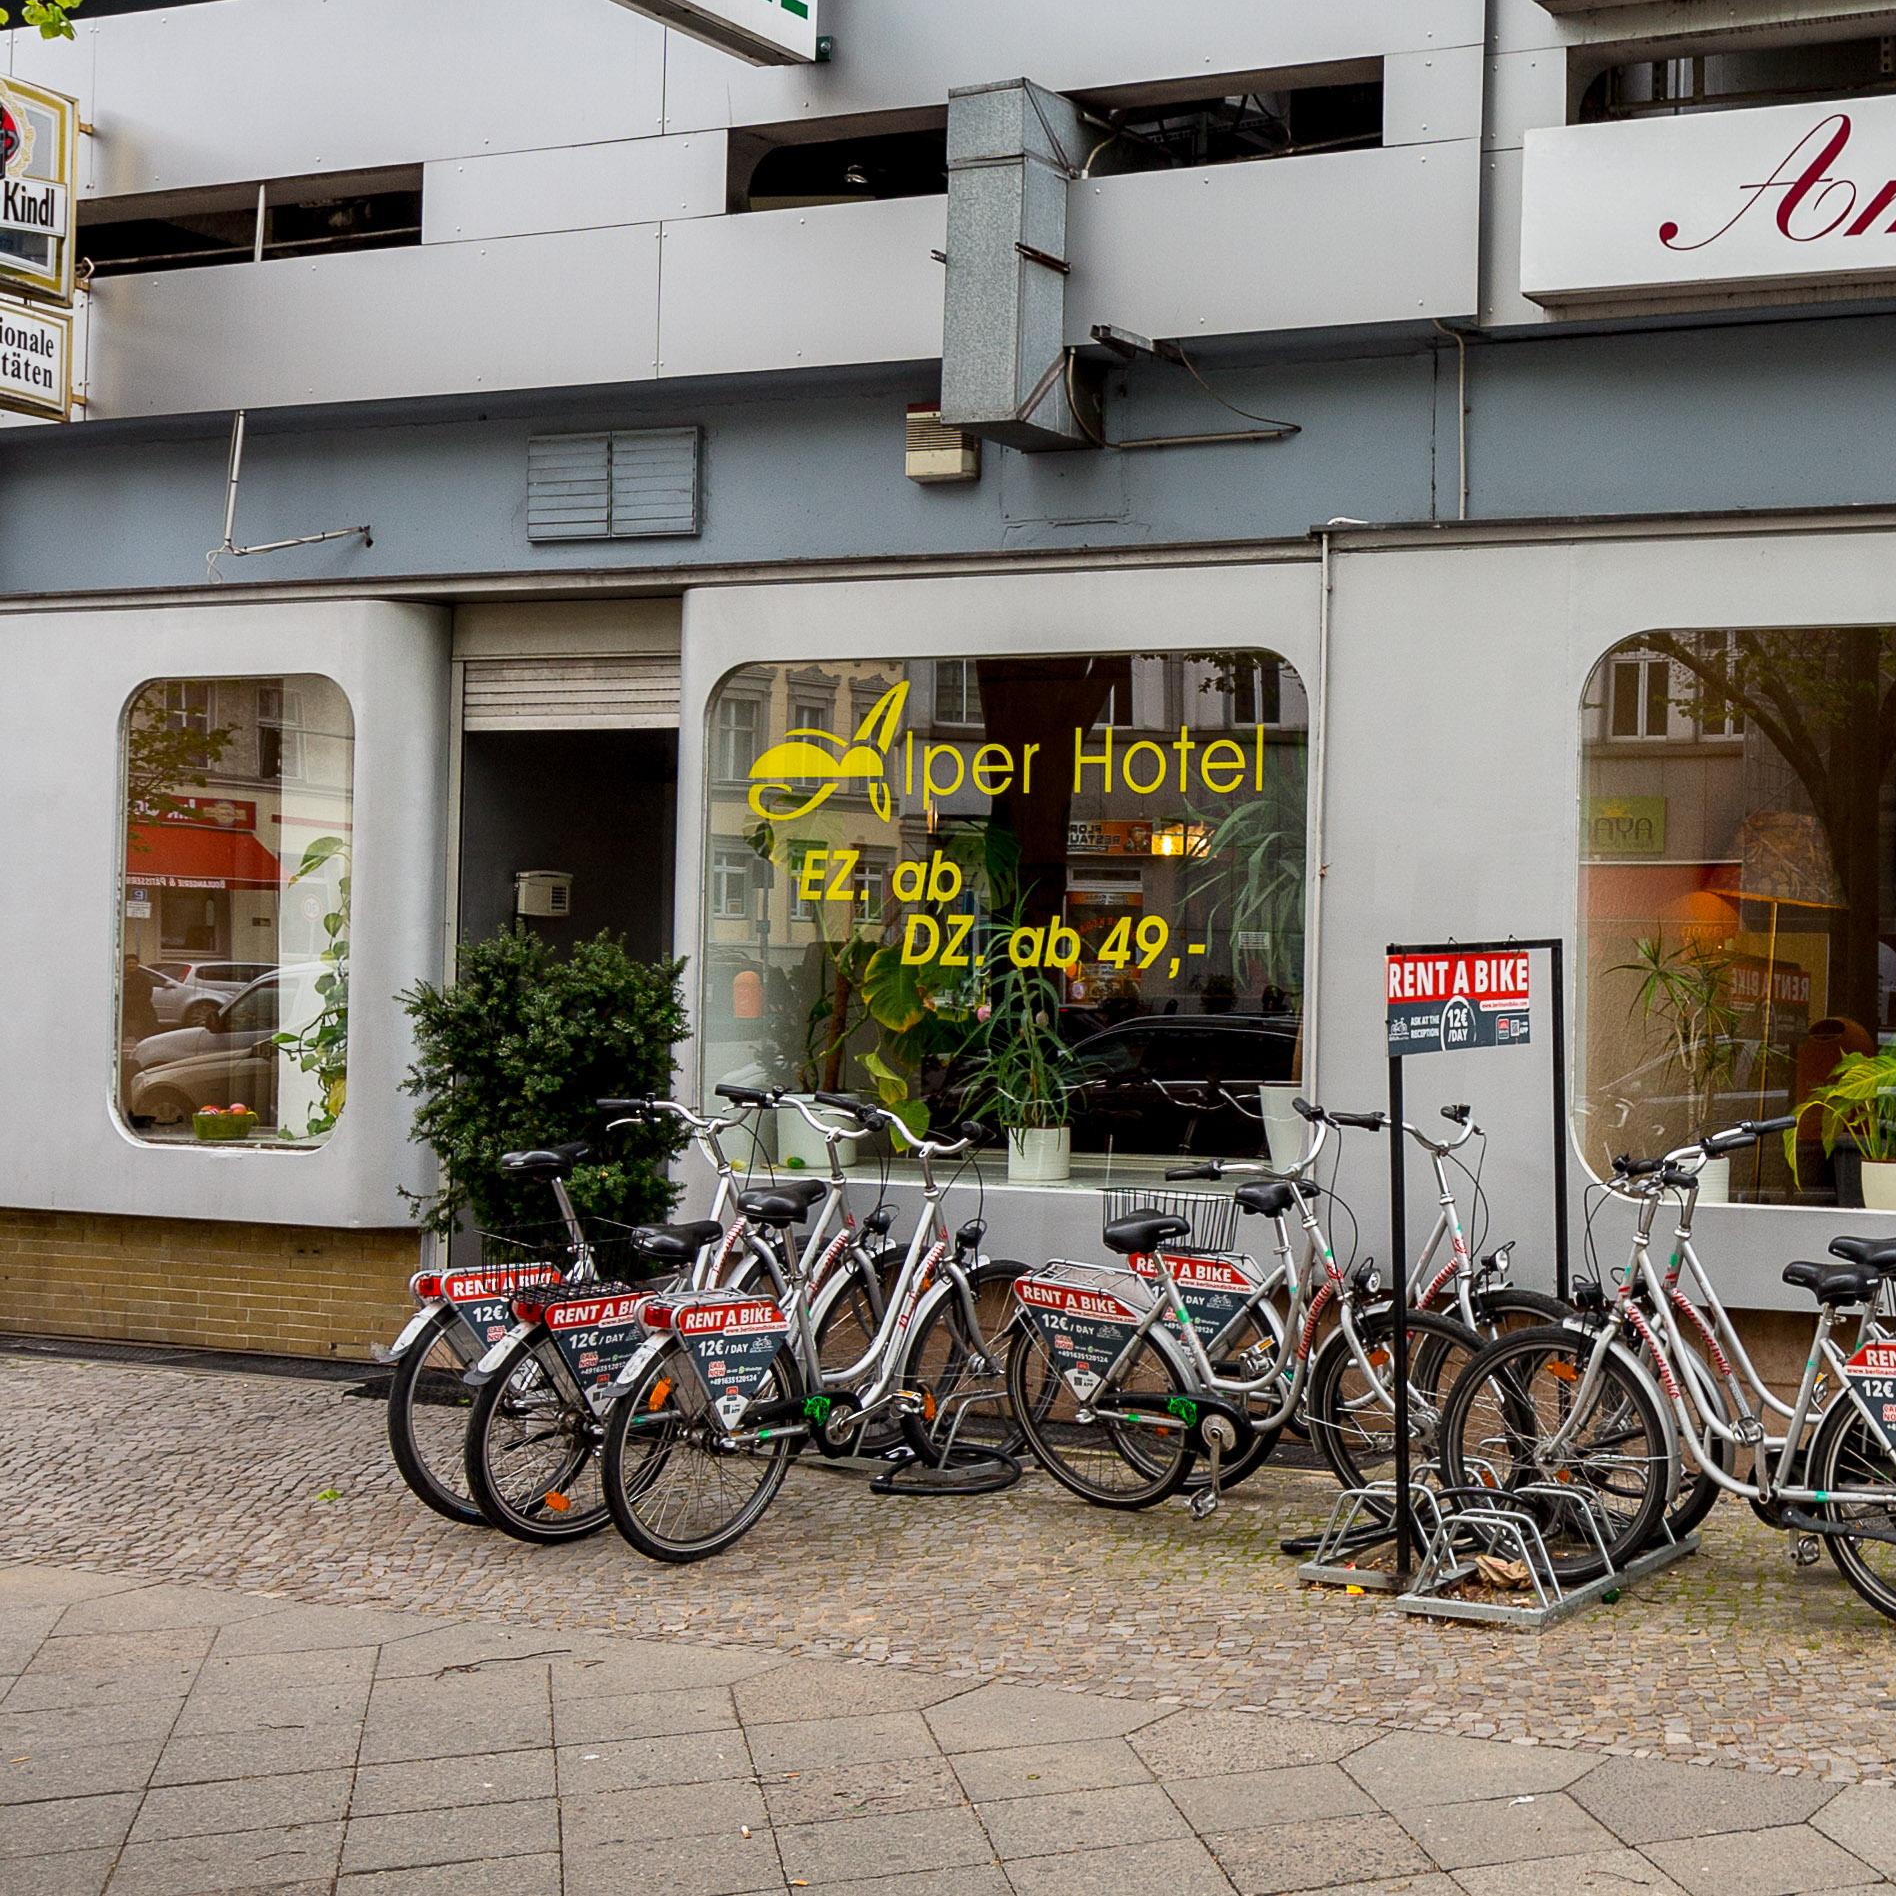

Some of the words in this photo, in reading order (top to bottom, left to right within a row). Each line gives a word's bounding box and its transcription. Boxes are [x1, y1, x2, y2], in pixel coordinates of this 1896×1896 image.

[4, 180, 55, 228] Kindl
[1074, 724, 1264, 796] Hotel
[799, 850, 869, 902] EZ.
[892, 851, 963, 902] ab
[900, 915, 986, 967] DZ.
[1008, 915, 1081, 968] ab
[1098, 913, 1206, 979] 49,-
[1388, 961, 1449, 998] RENT
[1452, 960, 1470, 994] A
[1474, 958, 1528, 993] BIKE
[1410, 1016, 1422, 1026] ASK
[1447, 1008, 1468, 1028] 12€
[1136, 1257, 1177, 1277] RET
[1180, 1263, 1192, 1278] A
[1195, 1265, 1232, 1283] BIKE
[1022, 1285, 1062, 1305] RENT
[1065, 1293, 1078, 1308] A
[1080, 1295, 1117, 1314] BIKE
[1186, 1295, 1205, 1305] DAY
[472, 1304, 504, 1322] 12€
[553, 1304, 600, 1324] RENT
[601, 1302, 615, 1319] A
[685, 1310, 724, 1330] RENT
[725, 1309, 737, 1326] A
[740, 1306, 773, 1324] BIKE
[1041, 1313, 1069, 1331] 12€
[1075, 1324, 1095, 1335] DAY
[569, 1331, 599, 1349] 12€
[605, 1333, 625, 1344] DAY
[698, 1339, 725, 1357] 12€
[730, 1343, 749, 1354] DAY
[1862, 1379, 1894, 1399] 12€
